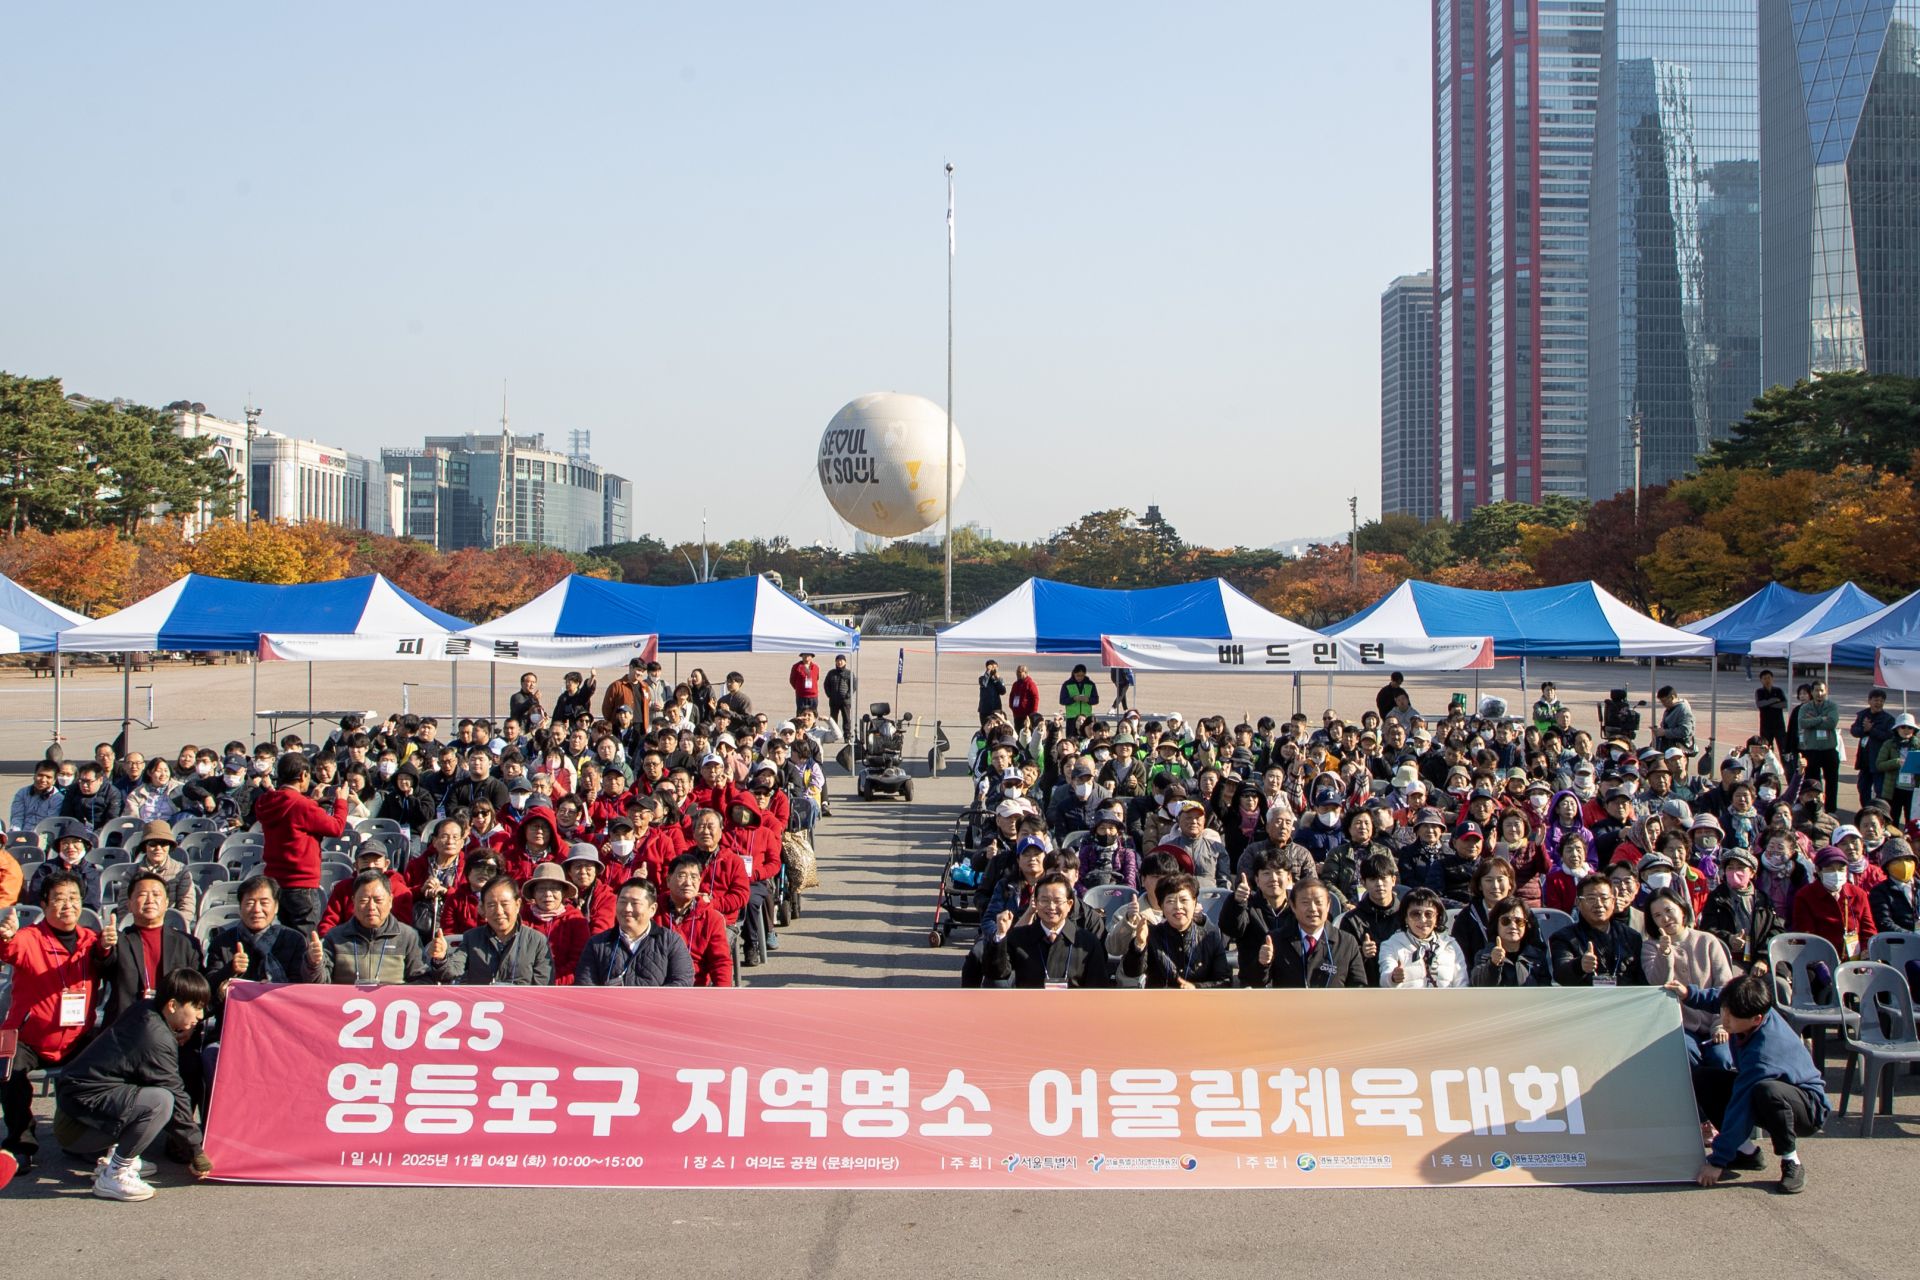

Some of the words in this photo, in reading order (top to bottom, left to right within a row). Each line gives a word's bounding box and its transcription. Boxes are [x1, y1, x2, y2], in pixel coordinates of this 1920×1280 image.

[833, 457, 880, 484] SOUL
[1217, 642, 1385, 665] 배드민턴
[1327, 791, 1334, 799] T
[339, 999, 504, 1051] 2025
[327, 1063, 640, 1136] 영등포구
[673, 1067, 993, 1138] 지역명소
[1030, 1065, 1586, 1138] 어울림체육대회
[402, 1154, 448, 1167] 2025년
[455, 1154, 484, 1167] 11월
[488, 1155, 518, 1167] 04일
[523, 1154, 547, 1168] (화)
[552, 1156, 644, 1168] 10:00~15:00
[746, 1156, 785, 1169] 여의도
[791, 1157, 818, 1169] 공원
[823, 1156, 900, 1170] (문화의마당)
[1021, 1156, 1077, 1169] 서울특별시
